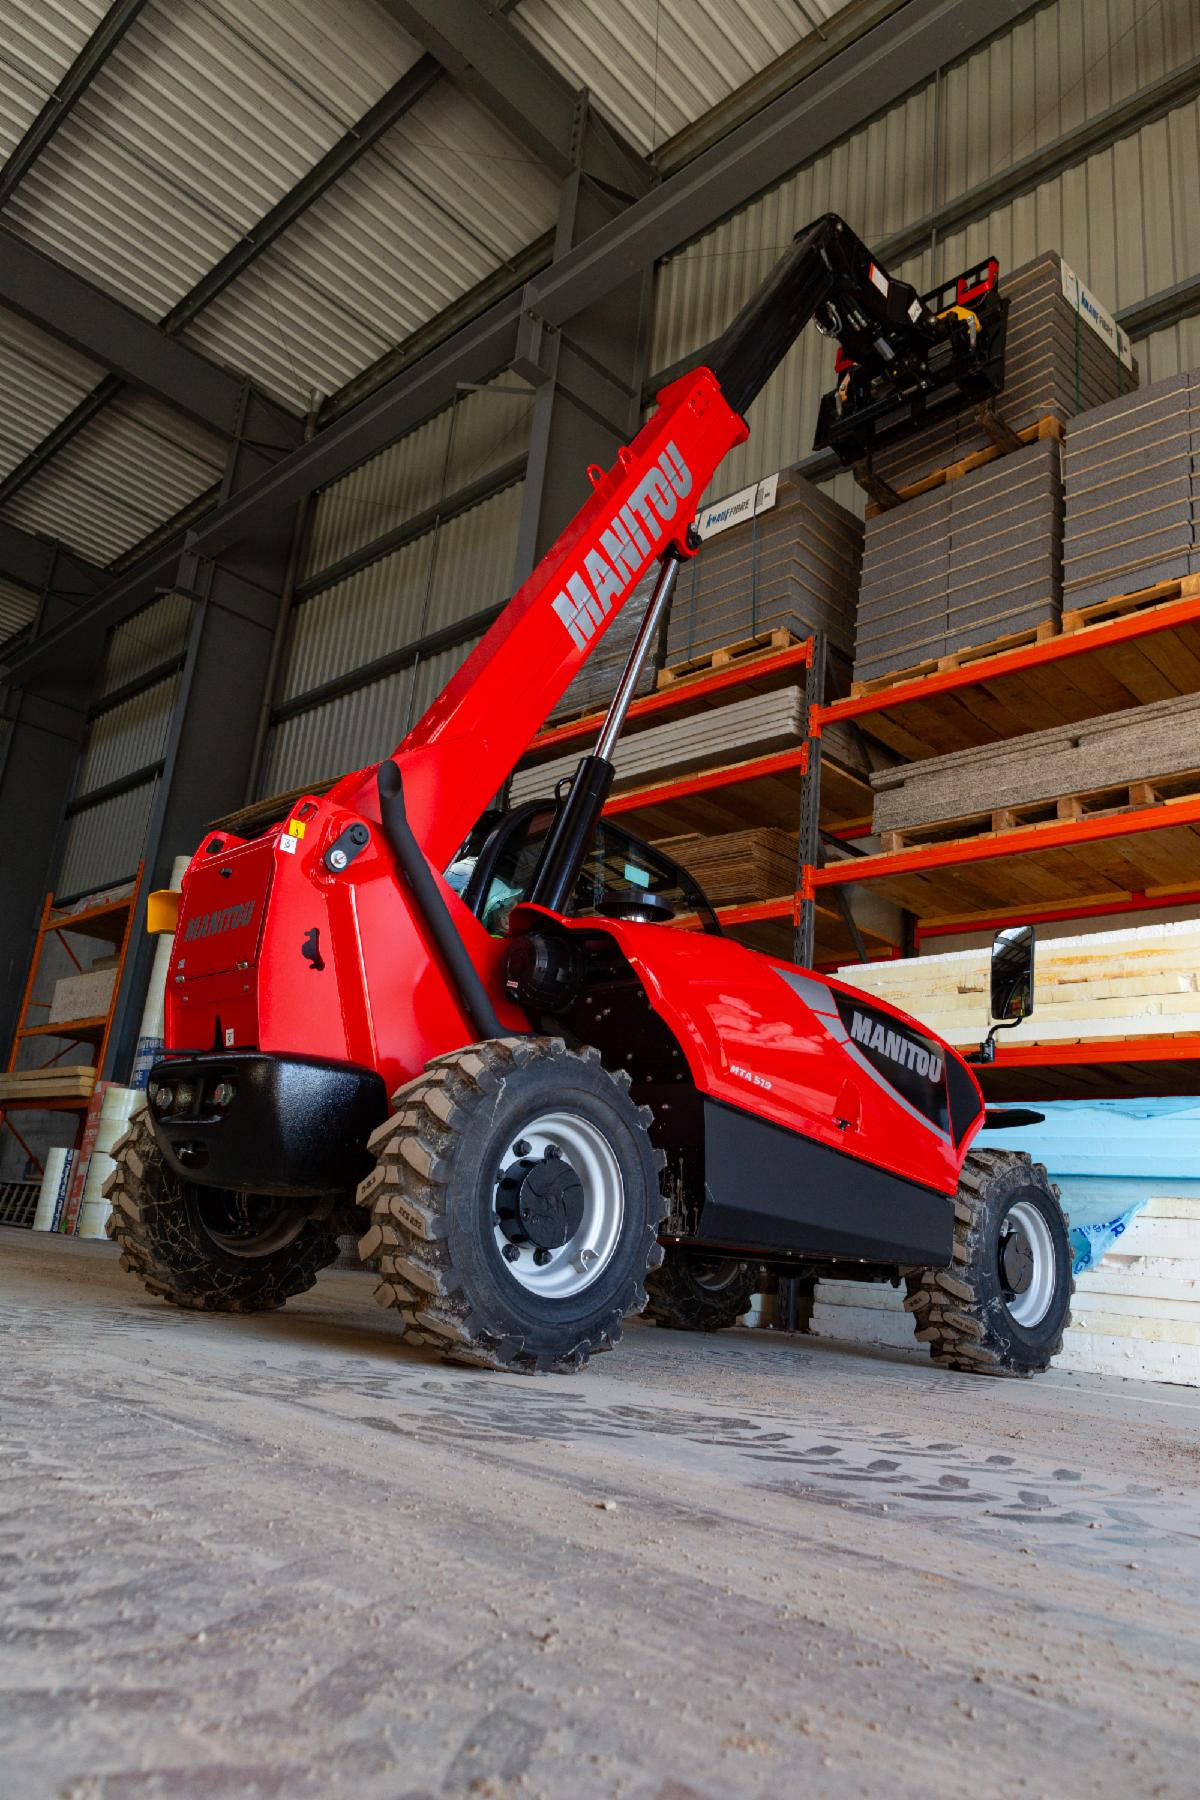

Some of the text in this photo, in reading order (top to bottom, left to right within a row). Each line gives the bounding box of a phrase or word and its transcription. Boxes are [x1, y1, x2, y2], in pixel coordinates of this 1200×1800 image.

[551, 440, 693, 652] MANITOU
[184, 899, 255, 942] MANITOU
[850, 1011, 944, 1083] MANITOU
[730, 1064, 772, 1090] MTA 519
